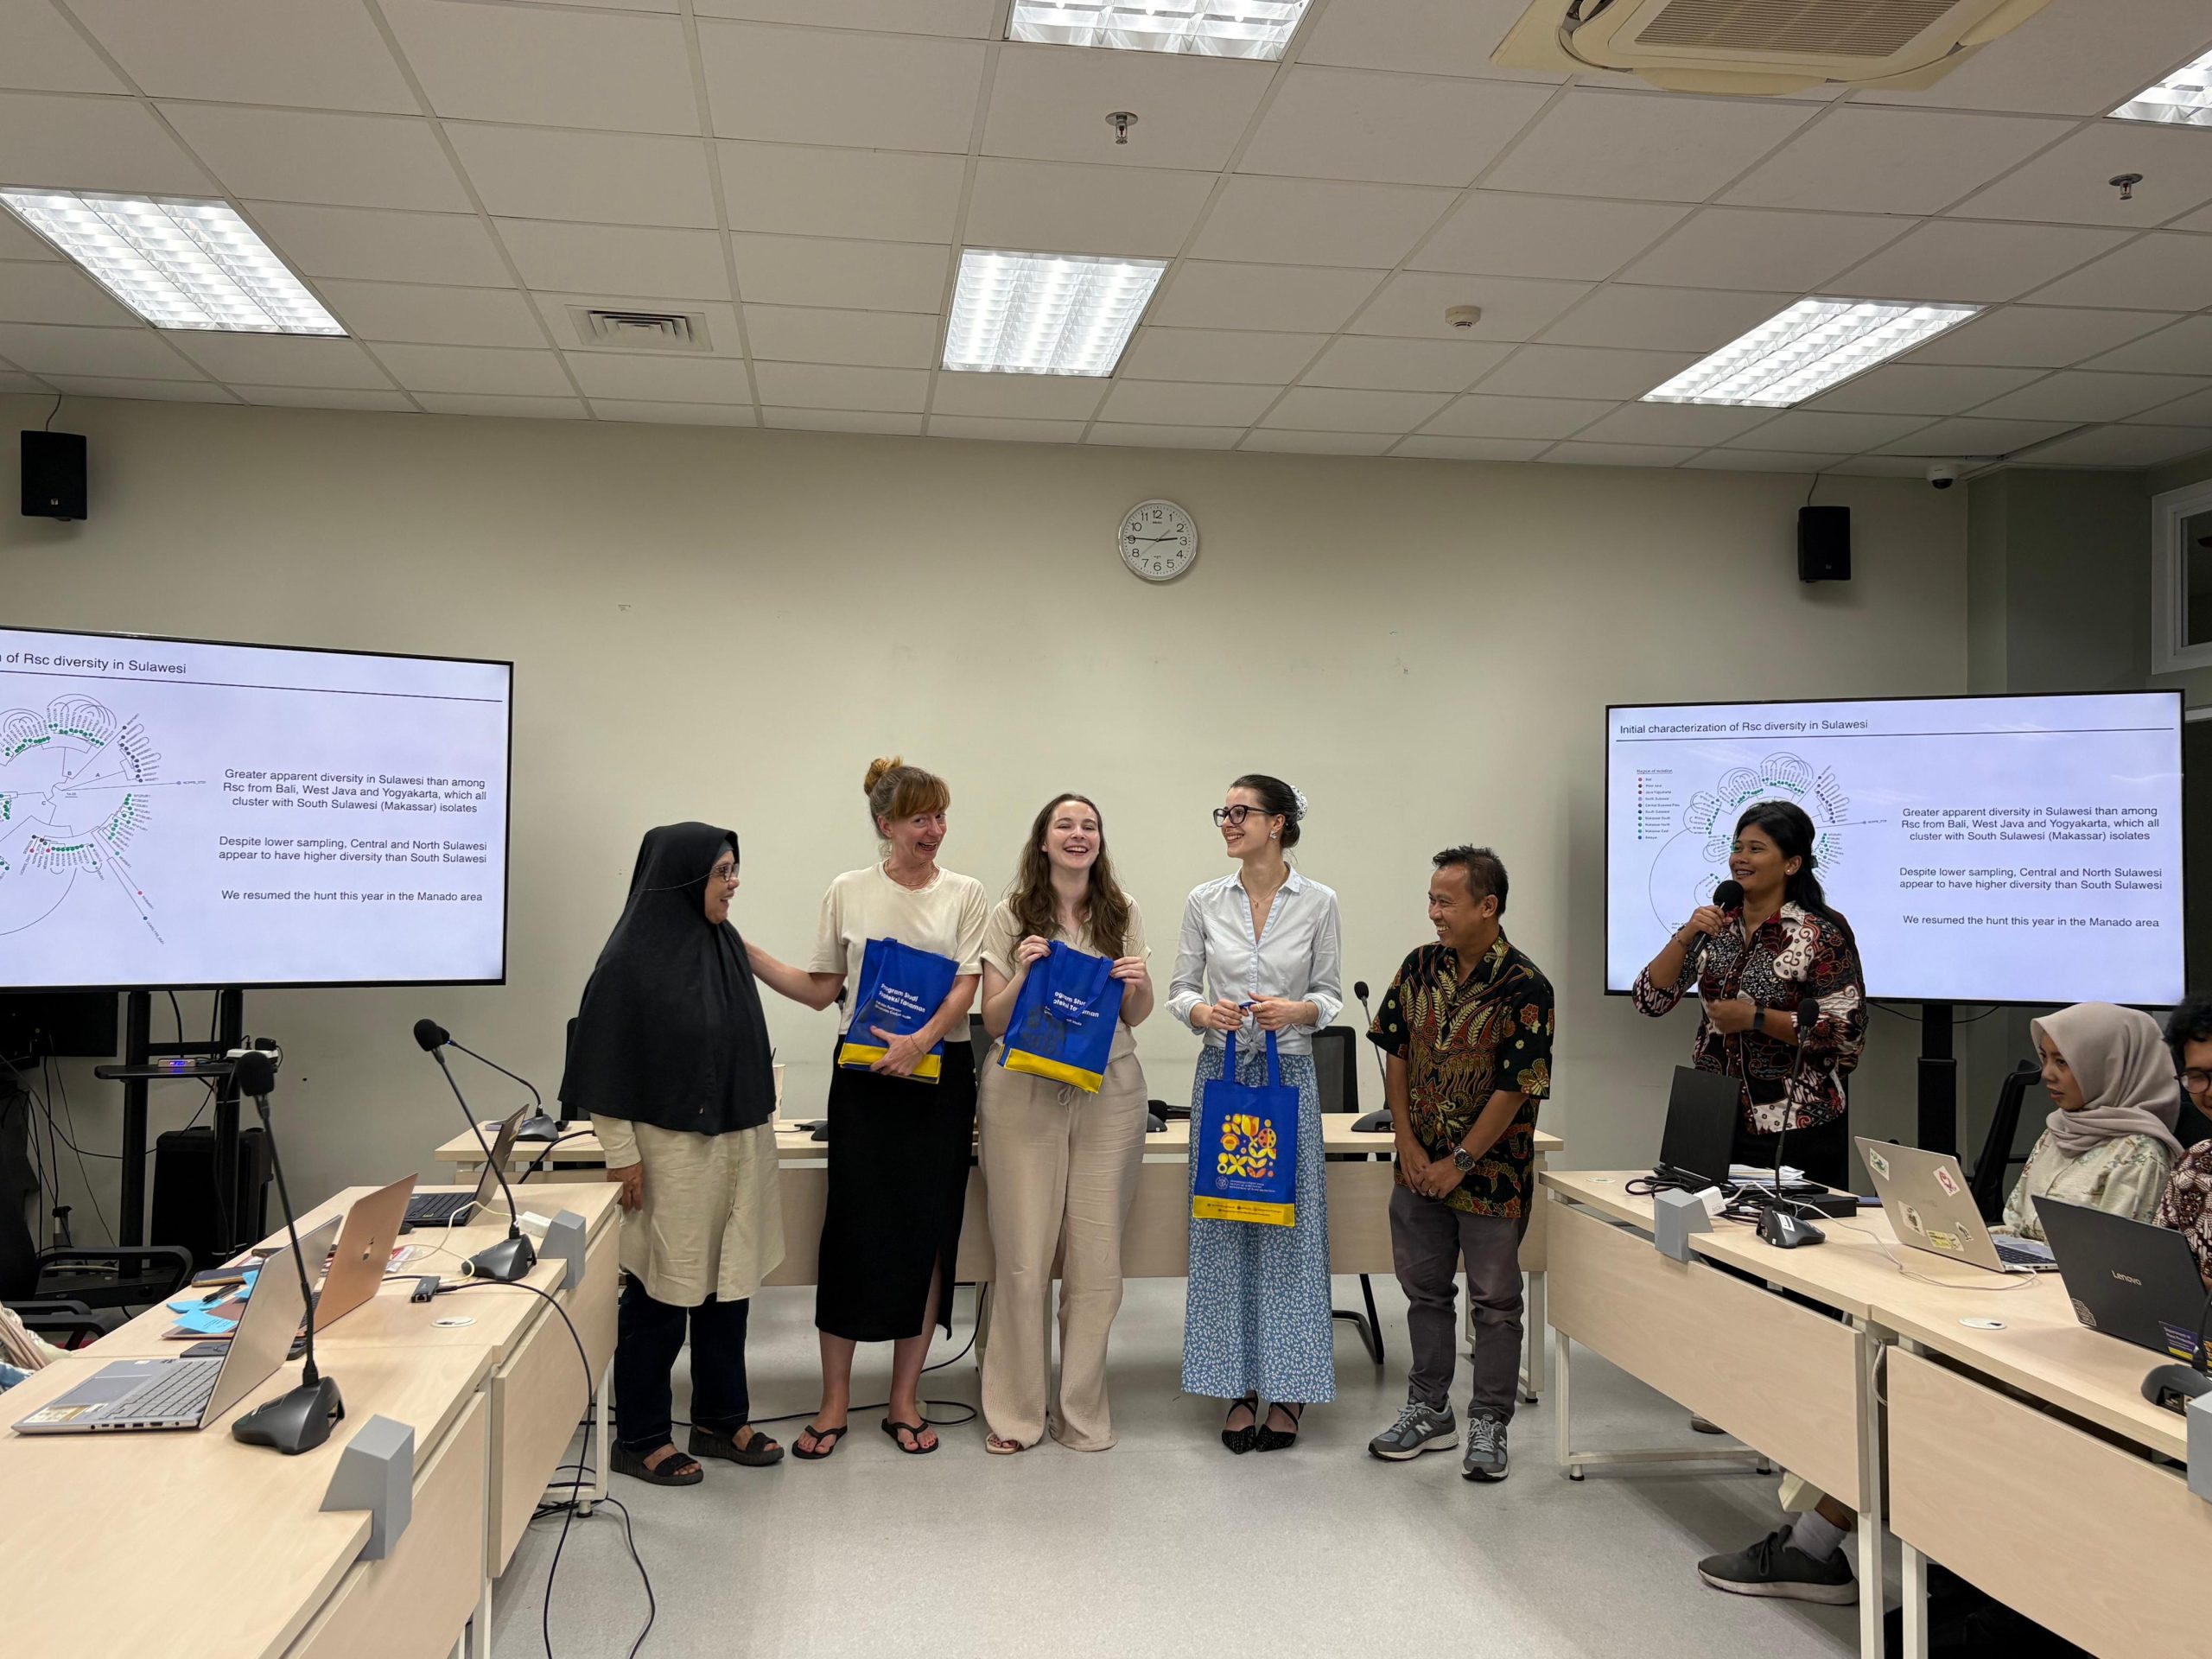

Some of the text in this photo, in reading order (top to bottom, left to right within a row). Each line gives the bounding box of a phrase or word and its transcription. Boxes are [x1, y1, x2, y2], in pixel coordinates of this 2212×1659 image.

[1141, 512, 1148, 521] 11
[1153, 510, 1162, 518] 12
[1169, 513, 1173, 522] 1
[1132, 522, 1141, 531] 10
[1177, 523, 1184, 532] 2
[1179, 537, 1187, 545] 3
[1132, 549, 1140, 557] 8
[1142, 559, 1148, 568] 7
[1154, 563, 1161, 571] 6
[1166, 559, 1174, 568] 5
[6, 652, 19, 663] of
[23, 654, 49, 664] Rsc
[53, 656, 109, 671] diversity
[112, 658, 124, 670] in
[128, 660, 186, 673] Sulawesi
[1620, 719, 1867, 734] Initial characterization of Rsc diversity in Sulawesi
[225, 769, 485, 789] Greater apparent diversity in Sulawesi than among
[223, 783, 486, 800] Rsc from Bali, West Java and Yogyakarta, which all
[232, 797, 477, 814] cluster with South Sulawesi (Makassar) isolates
[1902, 808, 1940, 817] Greater
[1942, 808, 1986, 817] apparent
[1988, 807, 2031, 817] diversity
[2045, 806, 2091, 816] Sulawesi
[2094, 806, 2118, 816] than
[2120, 808, 2157, 817] among
[1901, 818, 2158, 830] Rsc from Bali, West Java and Yogyakarta, which all
[1944, 831, 1964, 840] with
[1967, 831, 1996, 842] South
[1999, 830, 2044, 842] Sulawesi
[2048, 830, 2106, 842] (Makassar)
[2109, 831, 2150, 840] isolates
[219, 836, 486, 850] Despite lower sampling, Central and North Sulawesi
[219, 851, 257, 861] appear
[274, 850, 300, 860] have
[303, 850, 336, 862] higher
[339, 851, 382, 863] diversity
[385, 852, 407, 863] than
[410, 852, 439, 861] South
[442, 853, 486, 862] Sulawesi
[1899, 867, 1936, 877] Despite
[1968, 868, 2016, 878] sampling,
[2019, 867, 2056, 876] Central
[2059, 868, 2079, 876] and
[2082, 868, 2111, 876] North
[2113, 868, 2162, 876] Sulawesi
[1899, 880, 2162, 891] appear to have higher diversity than South Sulawesi
[221, 889, 239, 899] We
[243, 890, 290, 902] resumed
[293, 891, 310, 899] the
[314, 891, 336, 902] hunt
[340, 891, 358, 899] this
[360, 893, 384, 902] year
[386, 891, 395, 902] in
[397, 891, 414, 900] the
[417, 892, 457, 900] Manado
[1922, 915, 1964, 924] resumed
[1967, 916, 1983, 926] the
[1986, 916, 2008, 926] hunt
[2011, 916, 2029, 927] this
[2031, 918, 2055, 927] year
[2069, 917, 2086, 928] the
[2089, 917, 2132, 926] Manado
[2111, 1270, 2142, 1286] Lenovo
